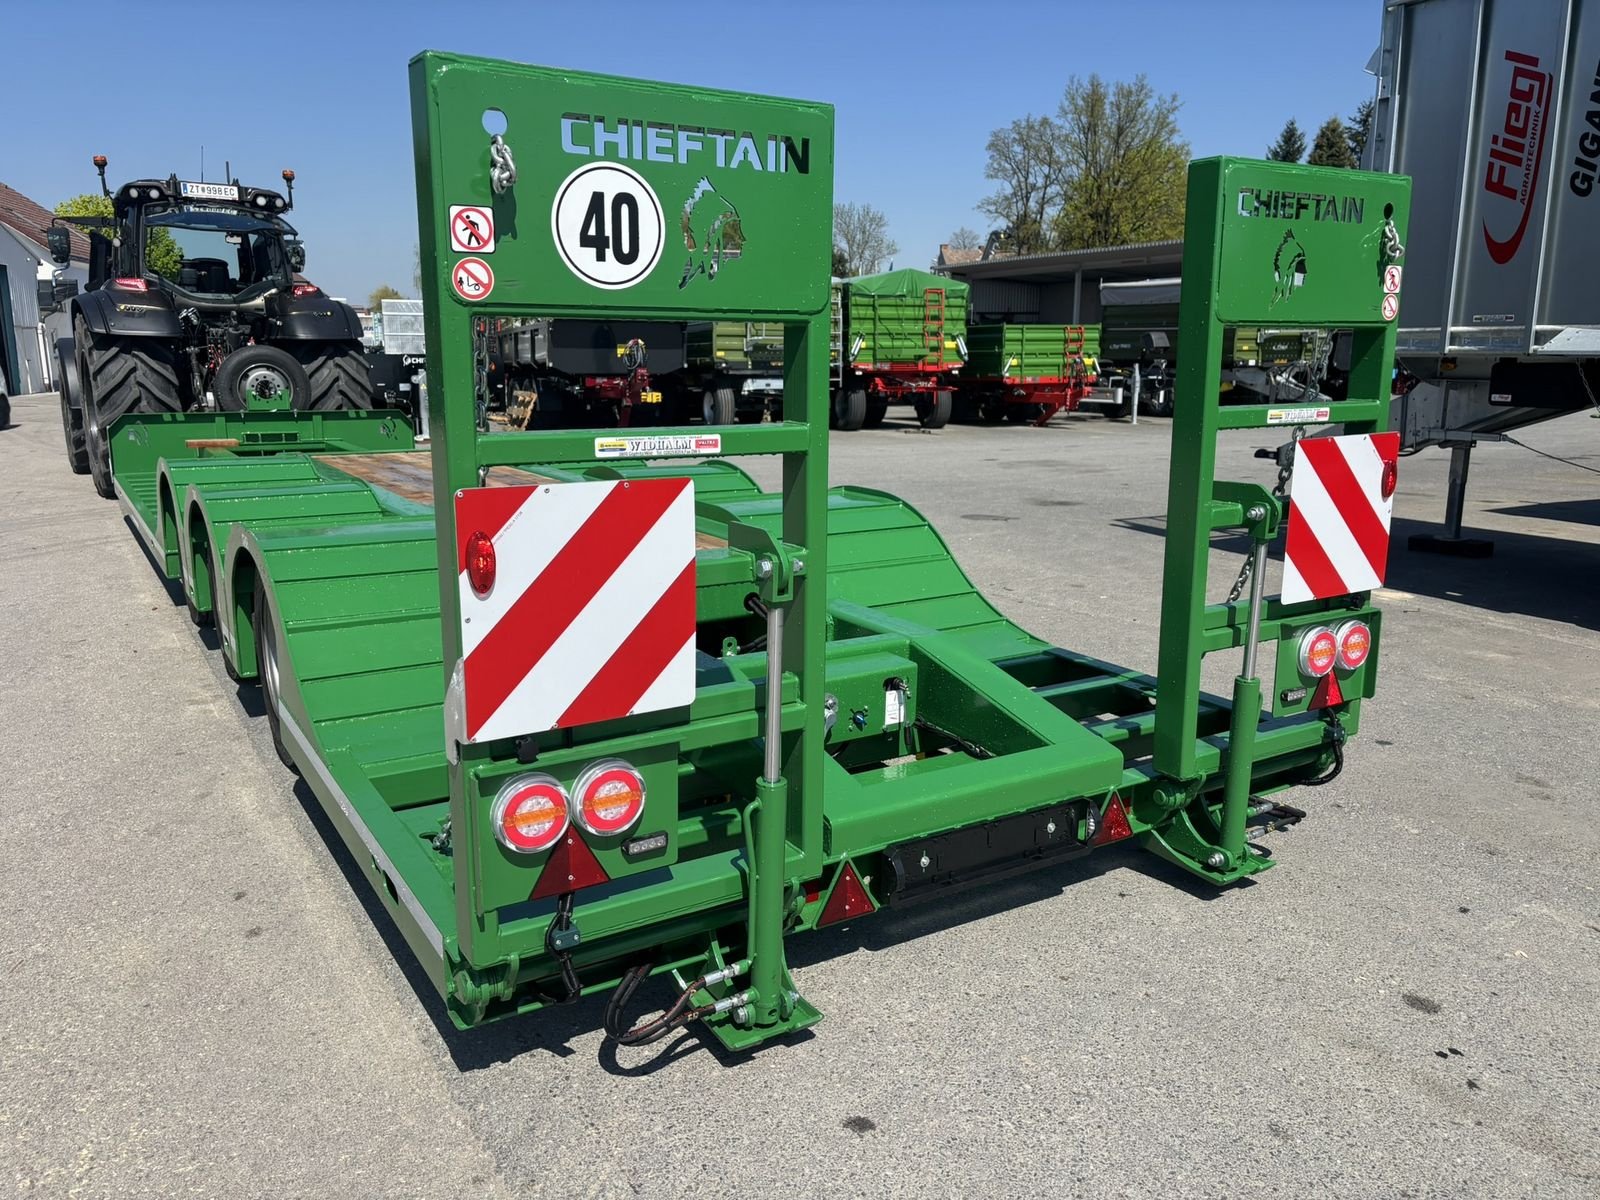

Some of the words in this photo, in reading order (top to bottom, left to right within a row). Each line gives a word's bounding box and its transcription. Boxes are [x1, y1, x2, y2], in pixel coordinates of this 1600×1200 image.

[561, 112, 810, 174] CHIEFTAIN
[1485, 50, 1546, 200] Fliegl
[1519, 110, 1541, 205] AGRARTECHNIK
[1569, 60, 1600, 198] GIGA
[579, 190, 640, 266] 40
[1238, 187, 1364, 224] CHIEFTAIN
[629, 439, 692, 452] WIDHALM
